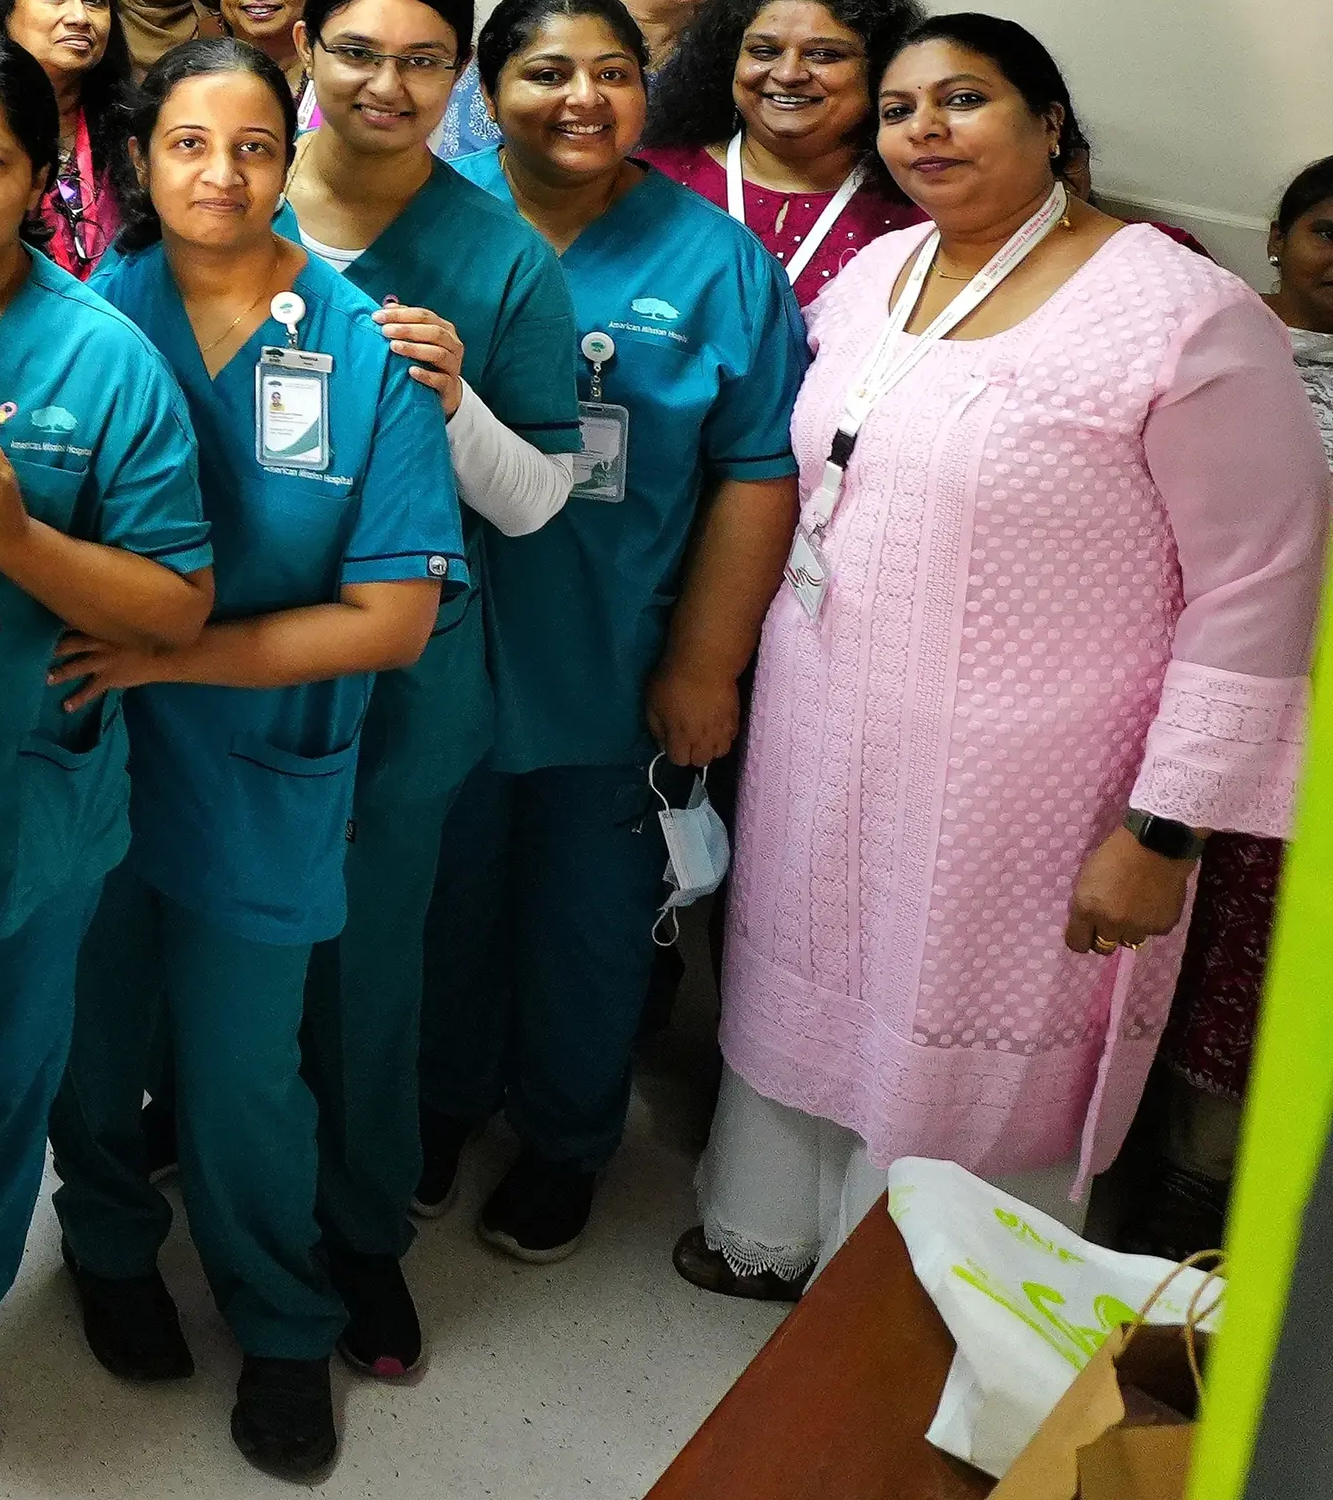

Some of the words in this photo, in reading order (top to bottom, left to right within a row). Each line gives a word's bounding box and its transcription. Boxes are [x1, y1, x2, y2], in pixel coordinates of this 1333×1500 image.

[608, 320, 641, 332] American
[641, 326, 667, 336] Mission
[324, 474, 353, 485] Hospital
